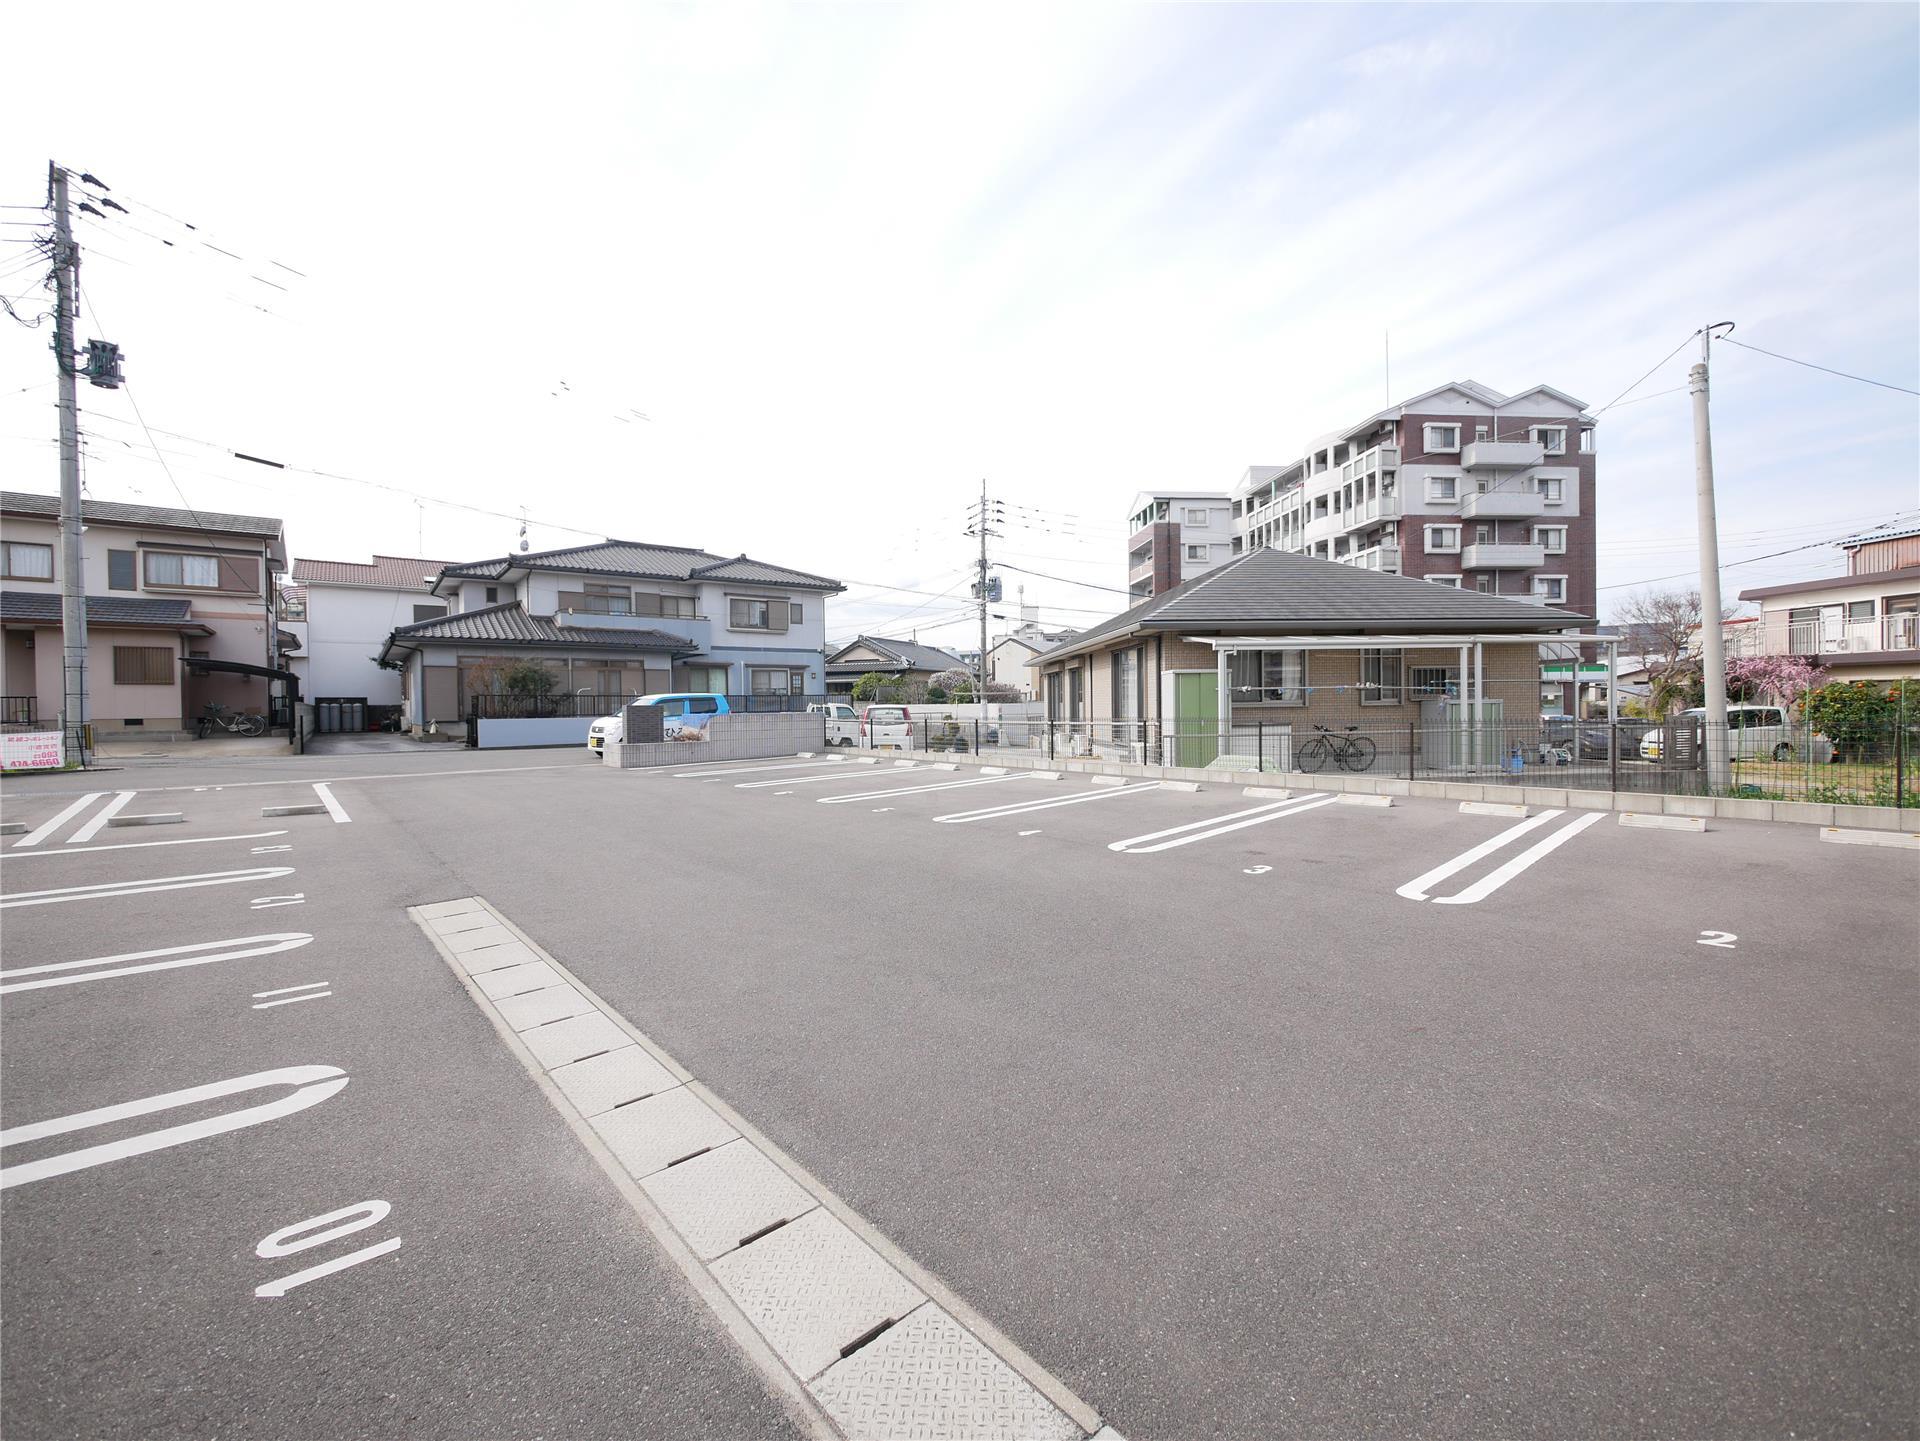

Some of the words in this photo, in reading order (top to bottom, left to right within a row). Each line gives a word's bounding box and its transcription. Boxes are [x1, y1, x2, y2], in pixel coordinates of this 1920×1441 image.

[10, 758, 60, 767] 474-6660
[1242, 864, 1273, 875] 3
[250, 892, 305, 910] 12
[1696, 930, 1738, 949] 2
[251, 981, 332, 1009] 11
[255, 1199, 402, 1299] 10
